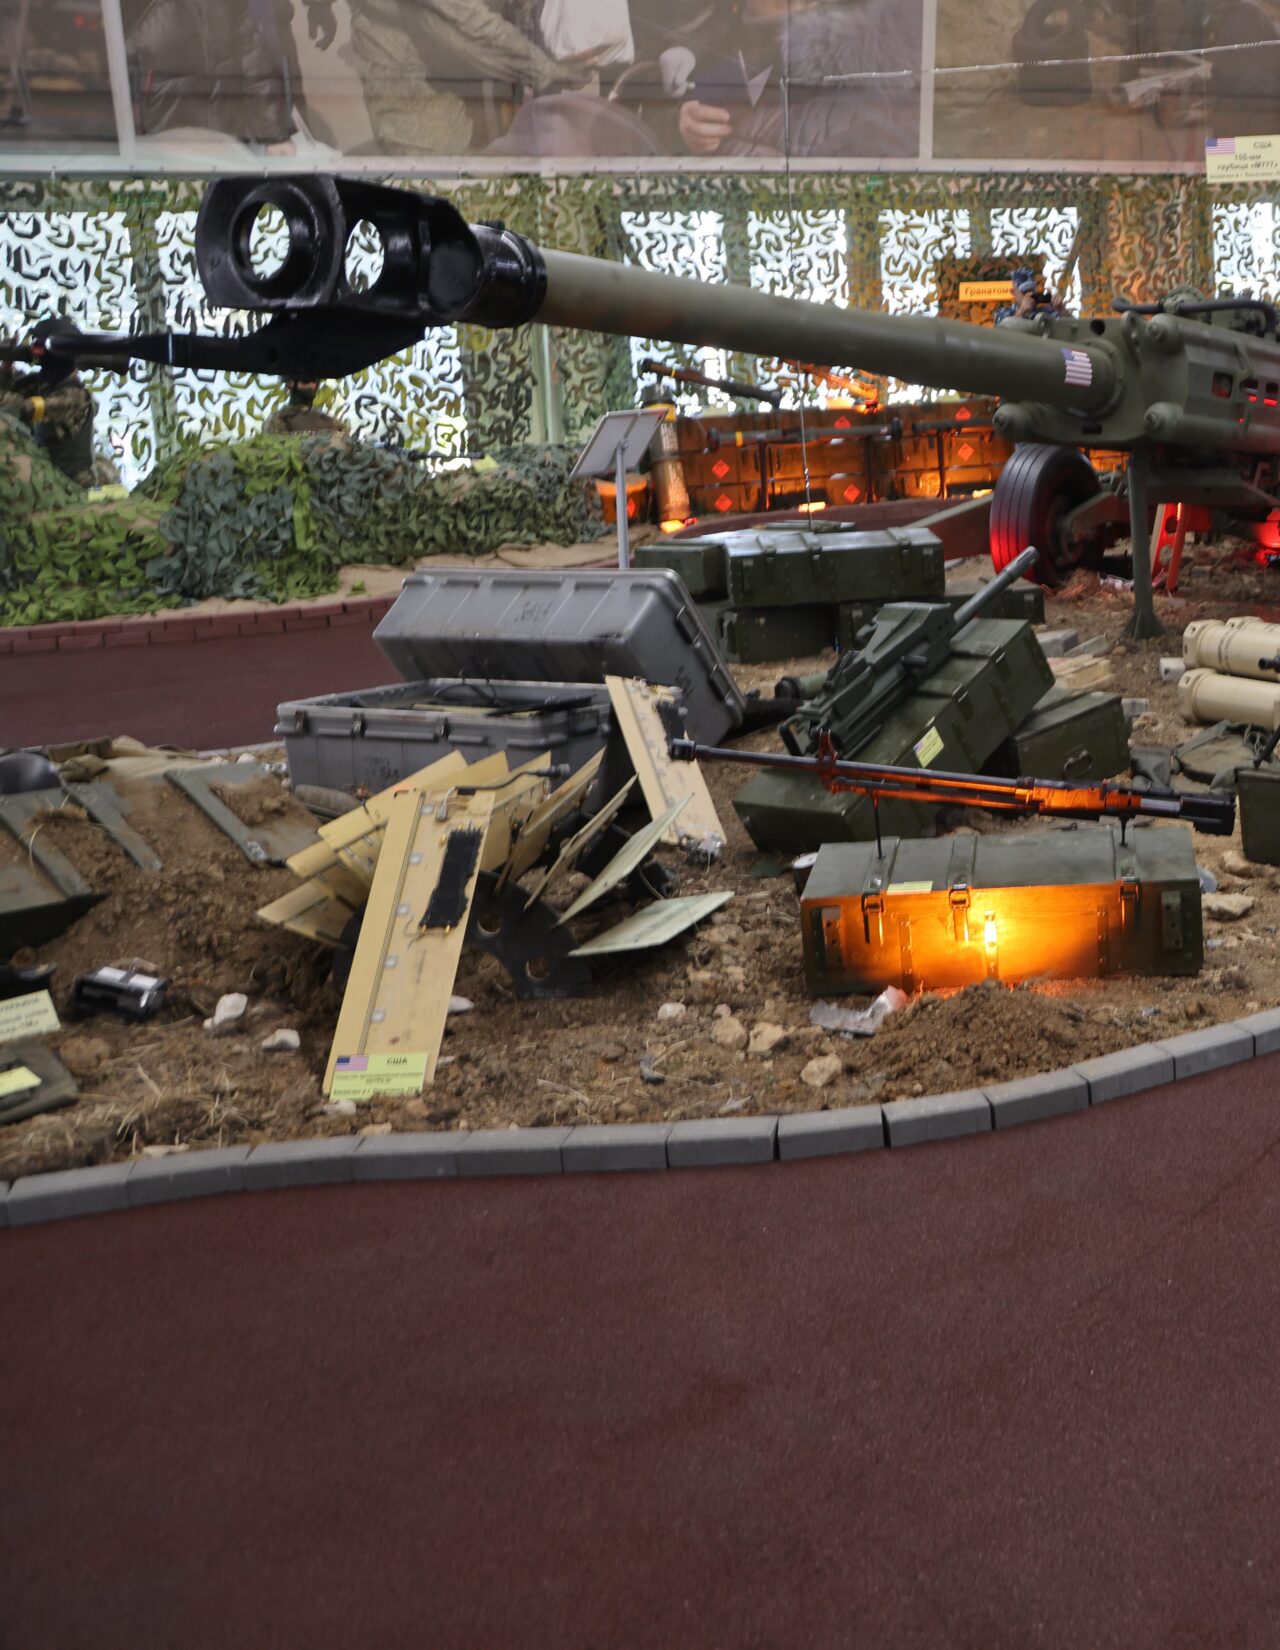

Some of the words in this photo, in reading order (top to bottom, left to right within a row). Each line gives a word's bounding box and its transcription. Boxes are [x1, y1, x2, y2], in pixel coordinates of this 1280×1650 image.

[1253, 140, 1273, 150] США
[965, 285, 1010, 297] Гранатом
[386, 1056, 409, 1066] США
